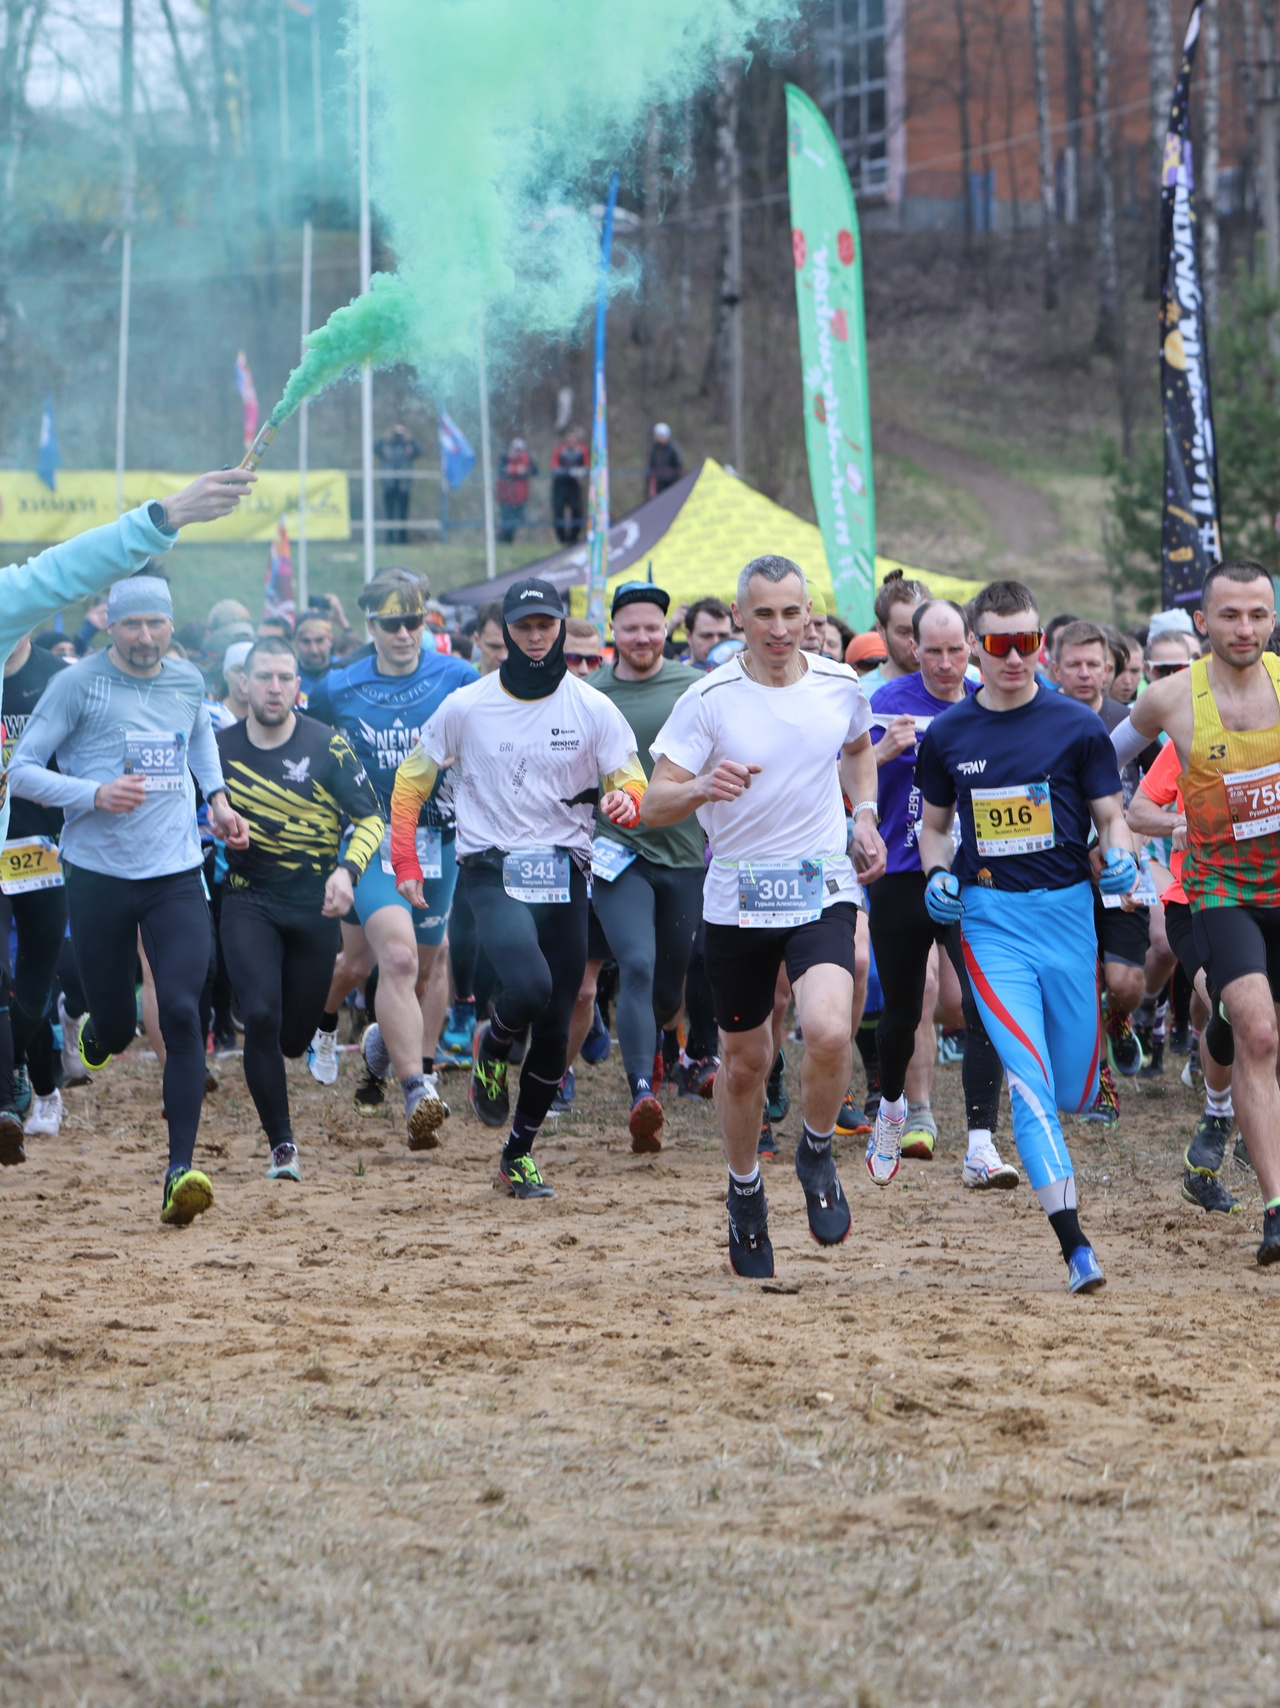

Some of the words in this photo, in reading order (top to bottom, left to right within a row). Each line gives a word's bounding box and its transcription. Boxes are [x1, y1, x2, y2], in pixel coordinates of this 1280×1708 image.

[361, 679, 431, 703] GOPRACTICE
[141, 748, 175, 767] 332
[989, 805, 1032, 828] 916
[10, 851, 43, 871] 927
[520, 861, 556, 879] 341
[758, 879, 803, 900] 301
[754, 900, 775, 908] Гурьев
[776, 900, 807, 908] Александр
